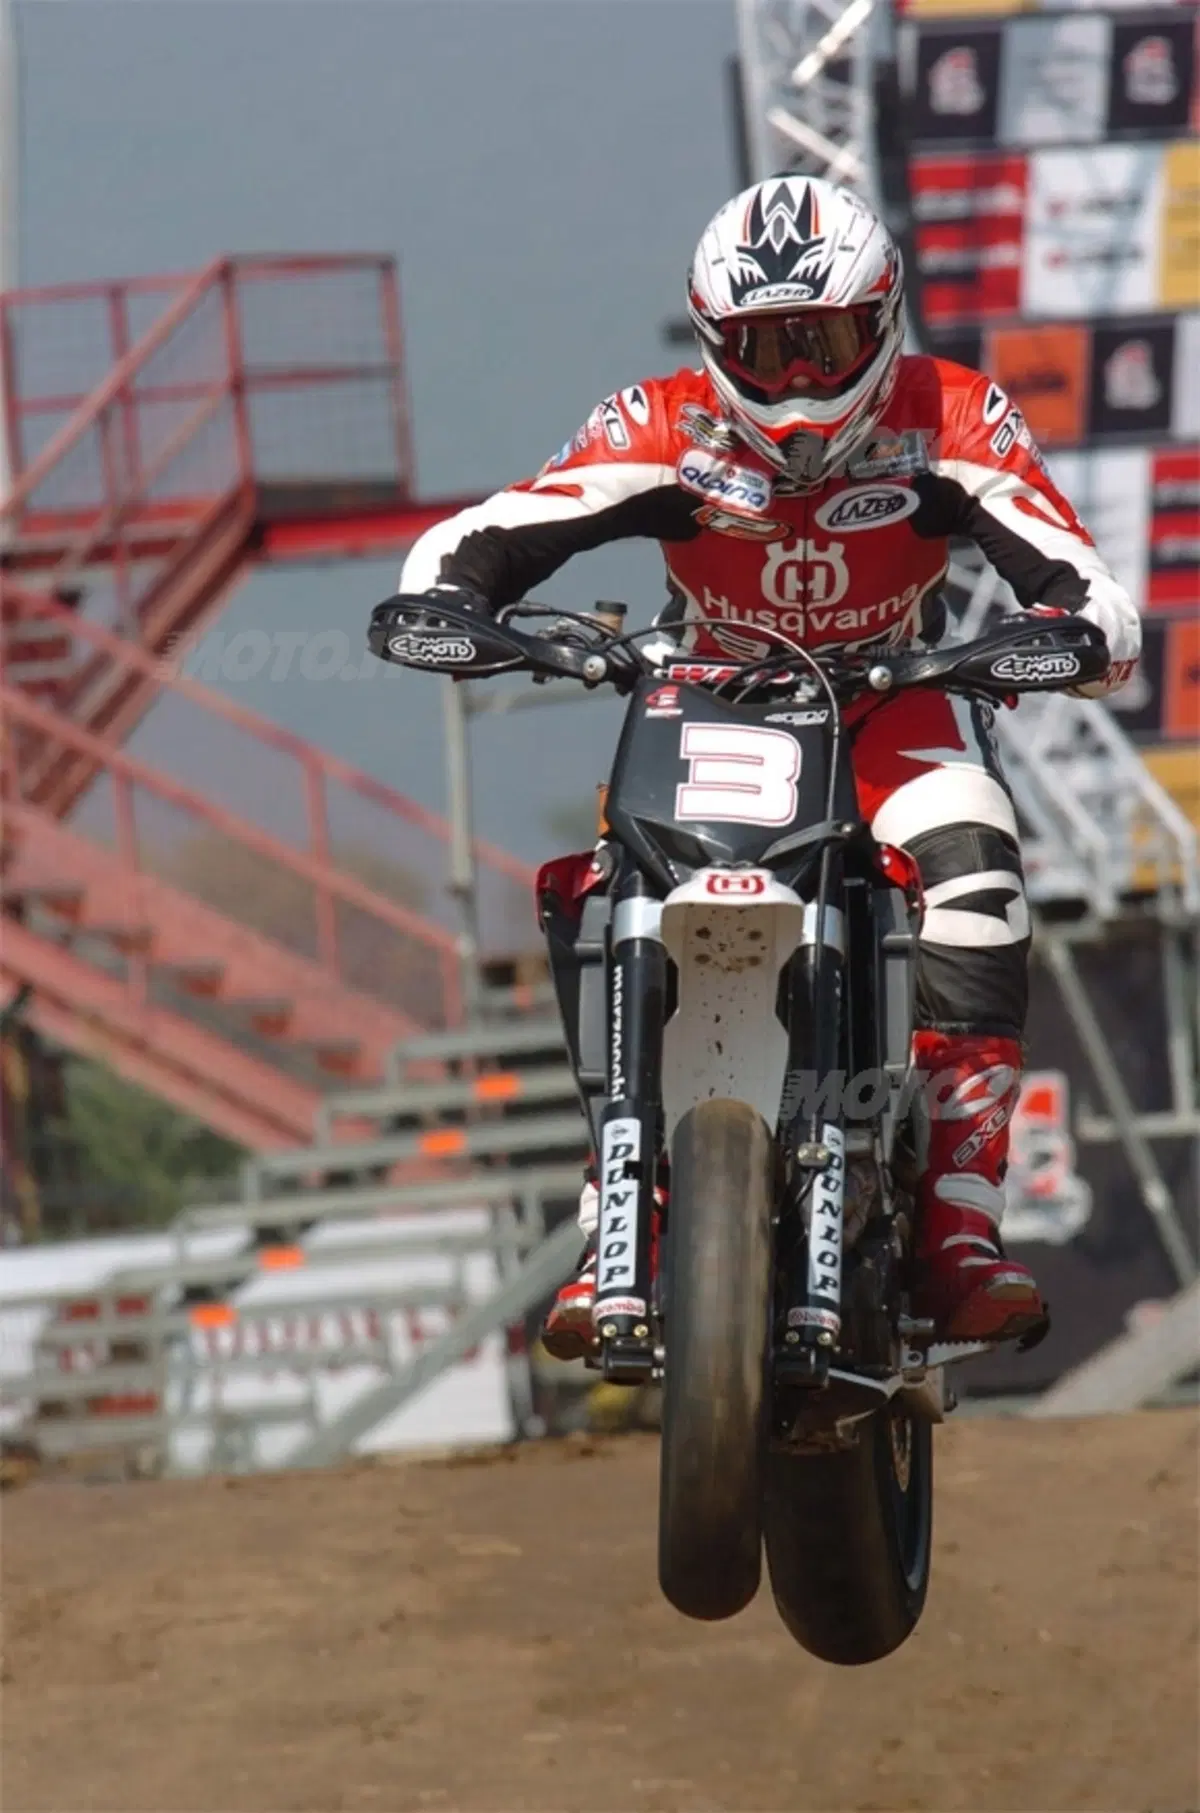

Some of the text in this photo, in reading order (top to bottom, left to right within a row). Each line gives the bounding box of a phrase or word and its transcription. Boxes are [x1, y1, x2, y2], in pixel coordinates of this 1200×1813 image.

[829, 493, 907, 525] LAZER
[702, 584, 919, 638] Husqvarna
[995, 658, 1076, 676] CEMOTO
[675, 722, 802, 827] 3
[603, 1143, 639, 1286] DUNLOP
[816, 1152, 841, 1292] DUNLOP
